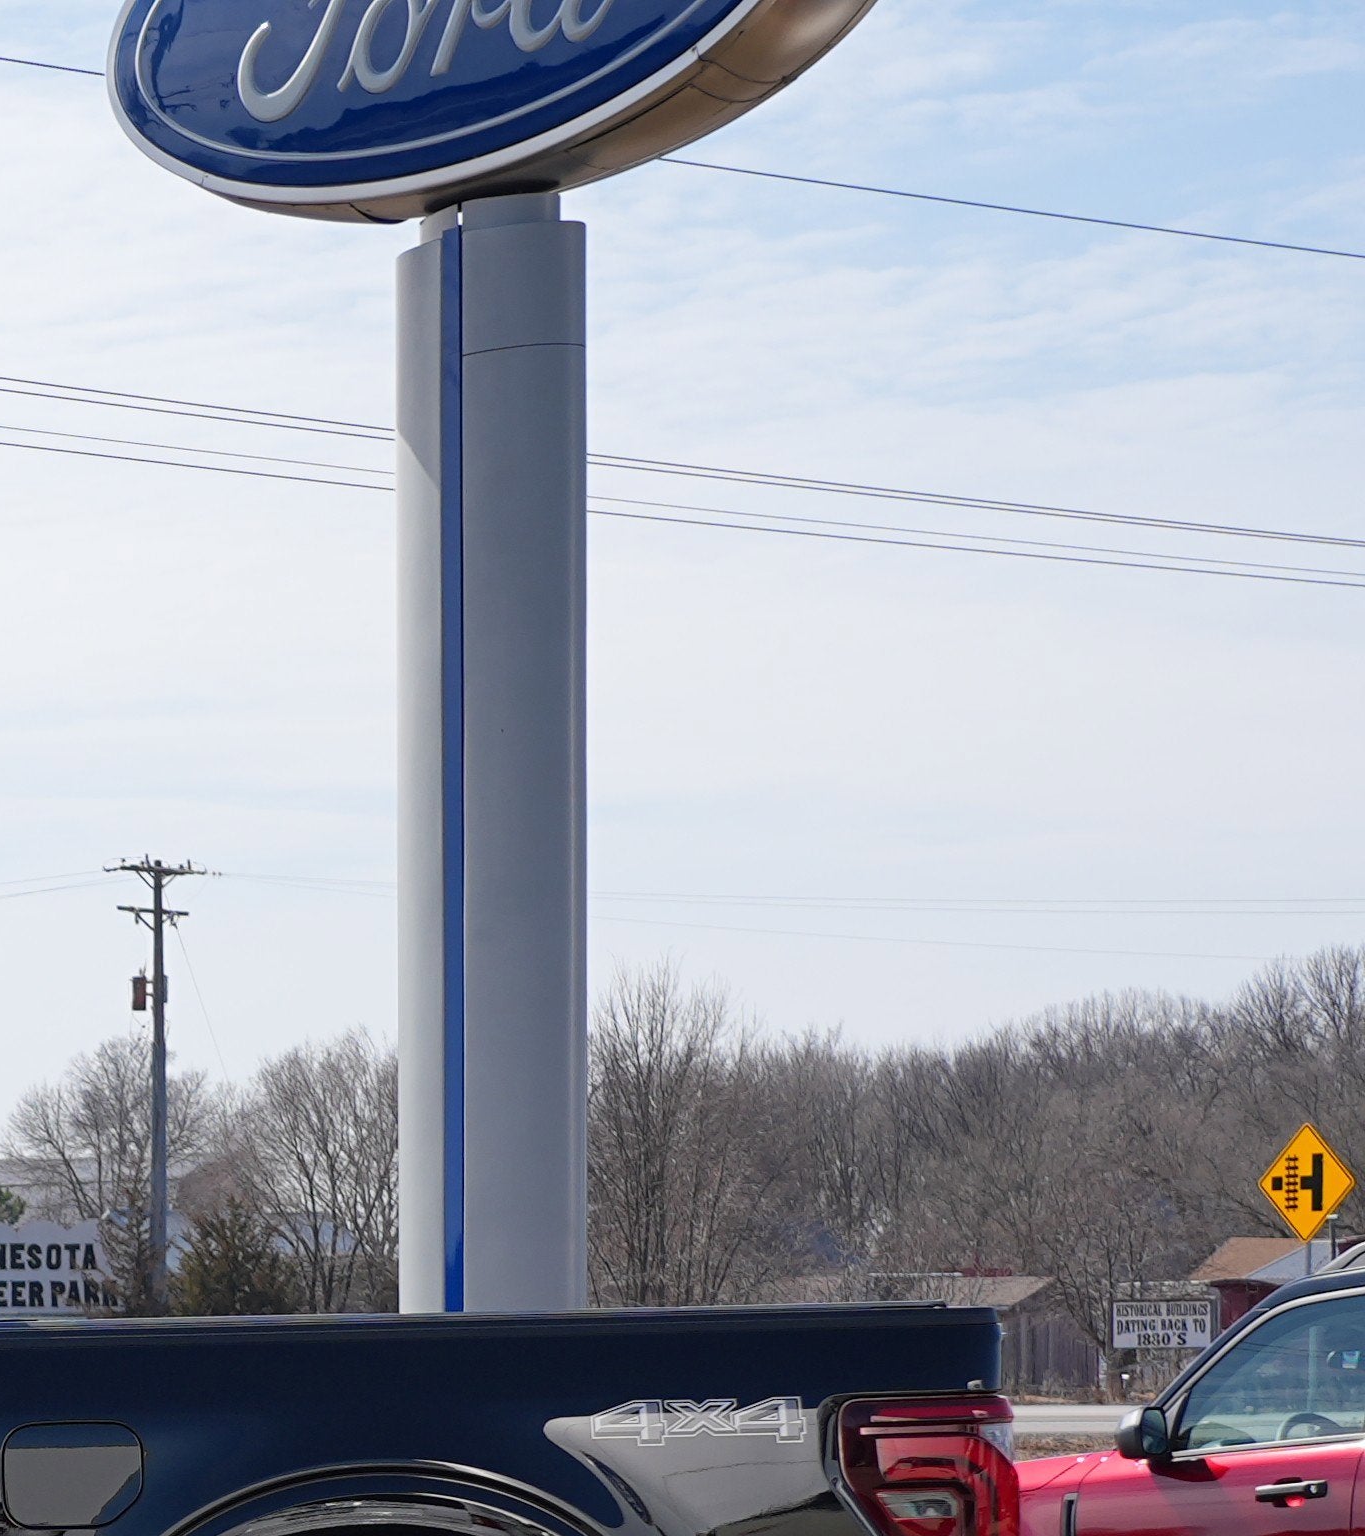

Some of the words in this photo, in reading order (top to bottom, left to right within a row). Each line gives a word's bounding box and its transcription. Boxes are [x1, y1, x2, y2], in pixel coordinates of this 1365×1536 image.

[1116, 1304, 1162, 1317] HISTORICAL
[1166, 1303, 1208, 1316] BUILDINGS
[1117, 1319, 1156, 1335] DATING
[1161, 1319, 1188, 1331] BACK
[1193, 1319, 1206, 1333] TO
